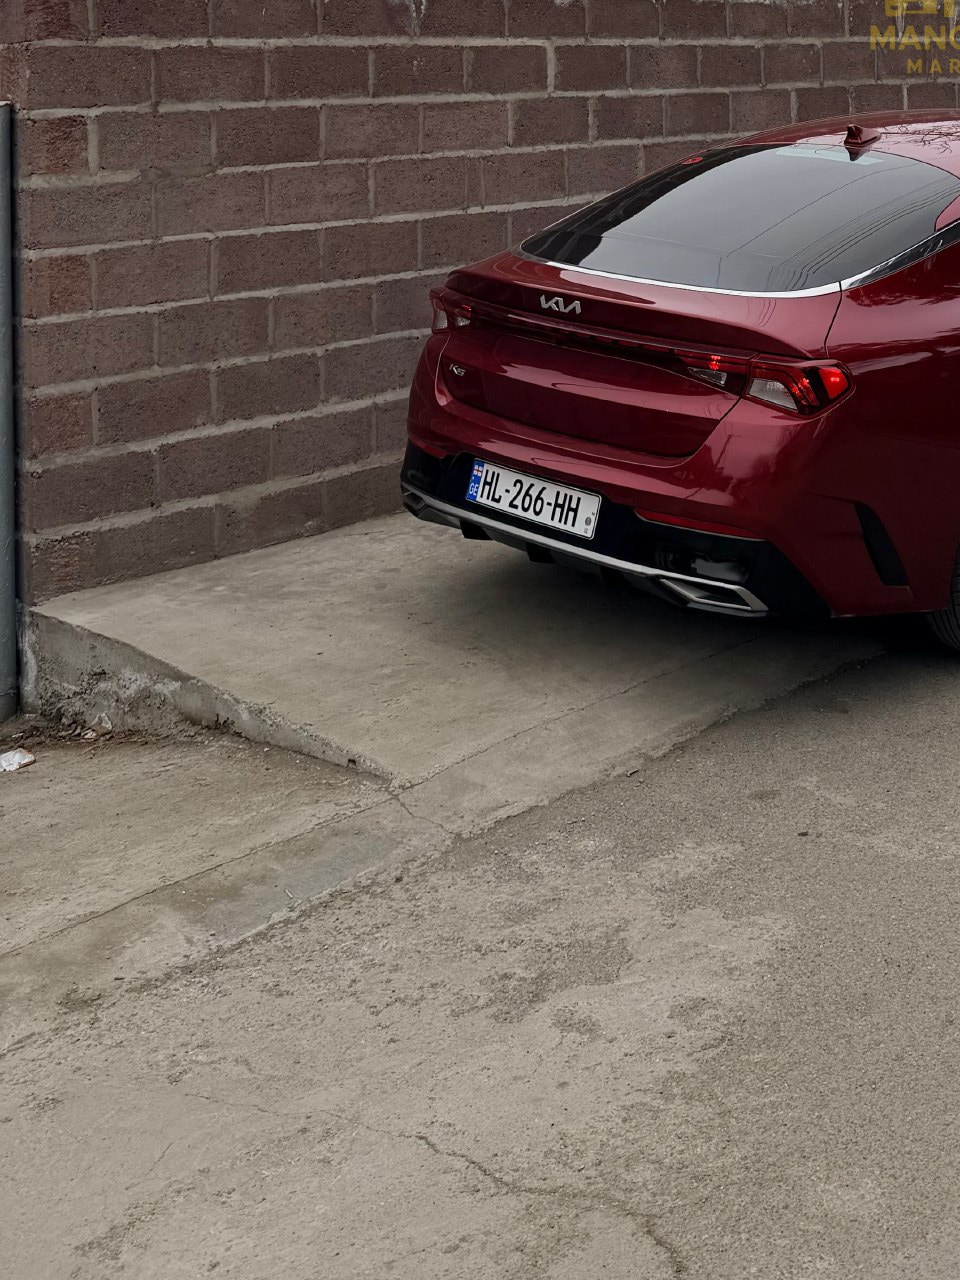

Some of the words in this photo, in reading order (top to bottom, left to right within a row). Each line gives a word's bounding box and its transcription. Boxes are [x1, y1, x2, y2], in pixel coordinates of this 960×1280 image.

[540, 294, 581, 315] KIA
[469, 483, 479, 496] GE
[480, 469, 581, 528] HL-266-HH
